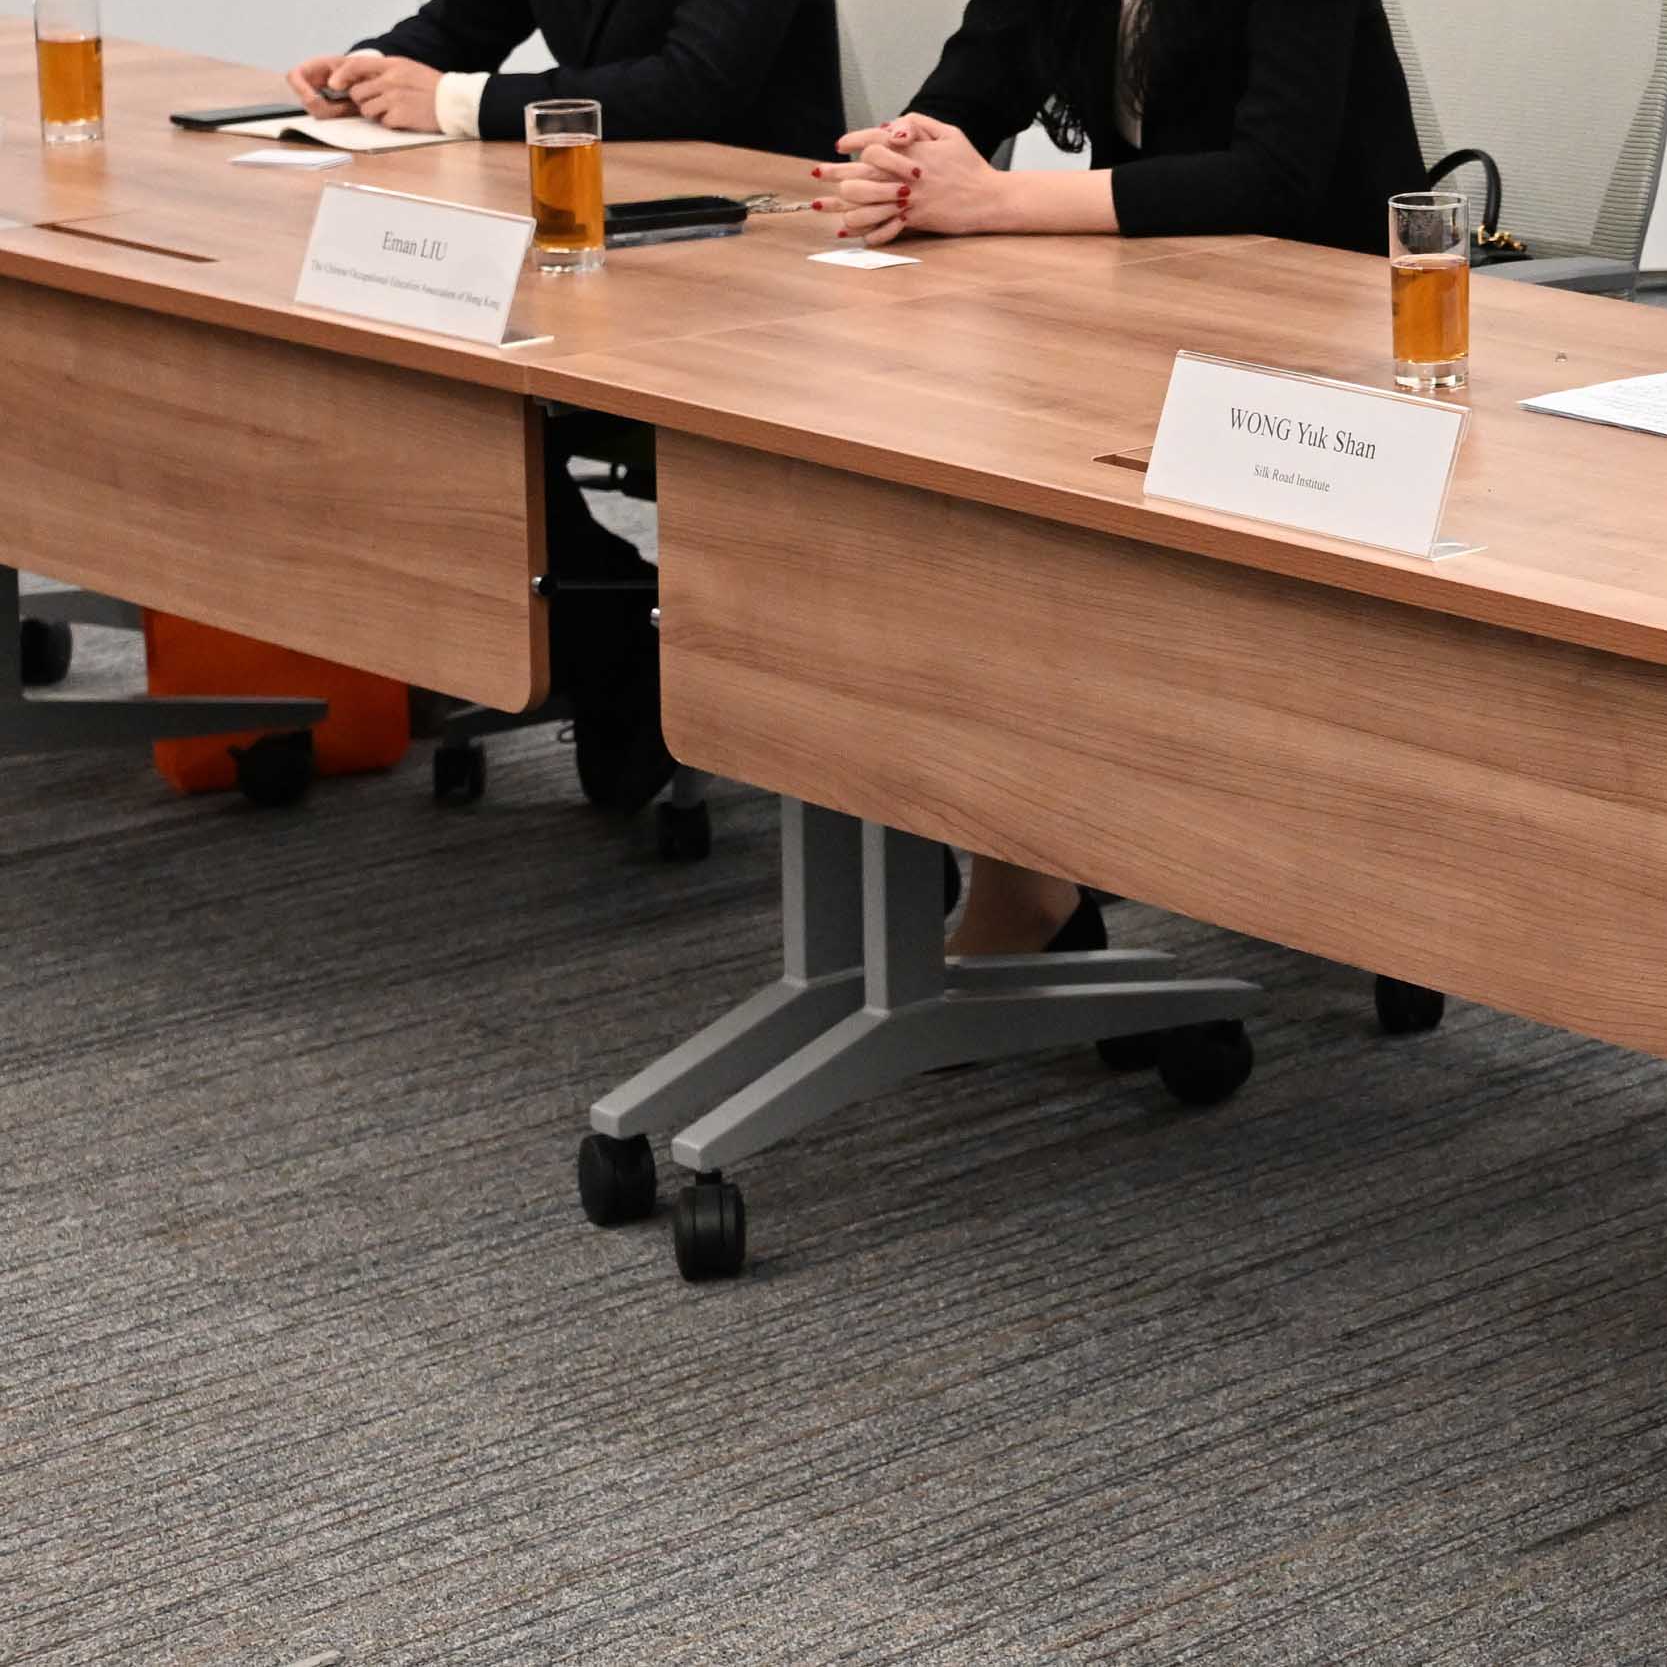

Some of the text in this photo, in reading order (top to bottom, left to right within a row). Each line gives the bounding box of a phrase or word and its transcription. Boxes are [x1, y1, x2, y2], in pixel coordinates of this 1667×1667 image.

[382, 230, 448, 262] Eman LIU
[1230, 407, 1377, 460] WONG Yuk Shan
[1254, 464, 1331, 493] Silk Road Institute
